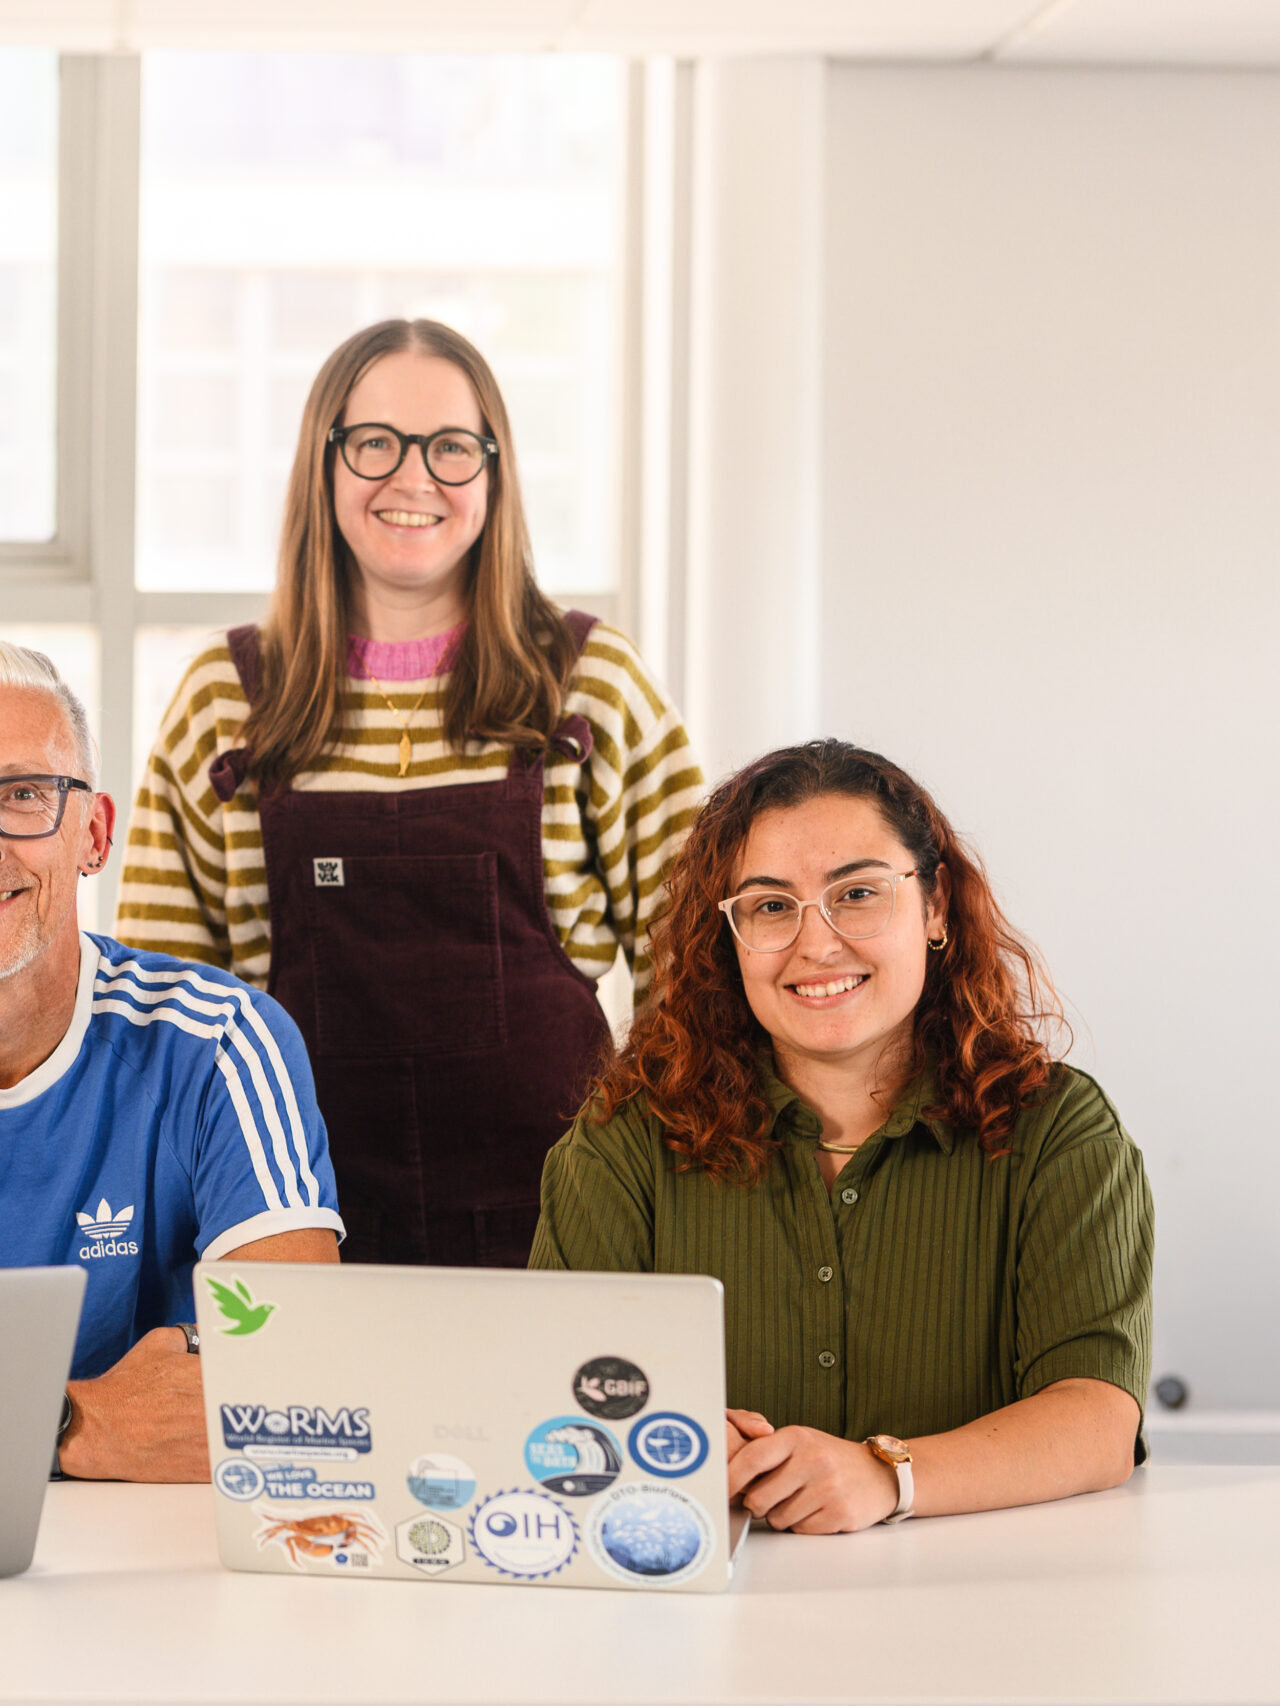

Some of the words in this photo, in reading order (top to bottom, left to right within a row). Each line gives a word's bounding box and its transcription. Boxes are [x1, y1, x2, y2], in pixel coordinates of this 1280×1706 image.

[79, 1239, 138, 1259] adidas
[604, 1379, 647, 1397] GBIF
[266, 1483, 303, 1497] THE
[306, 1484, 372, 1498] OCEAN
